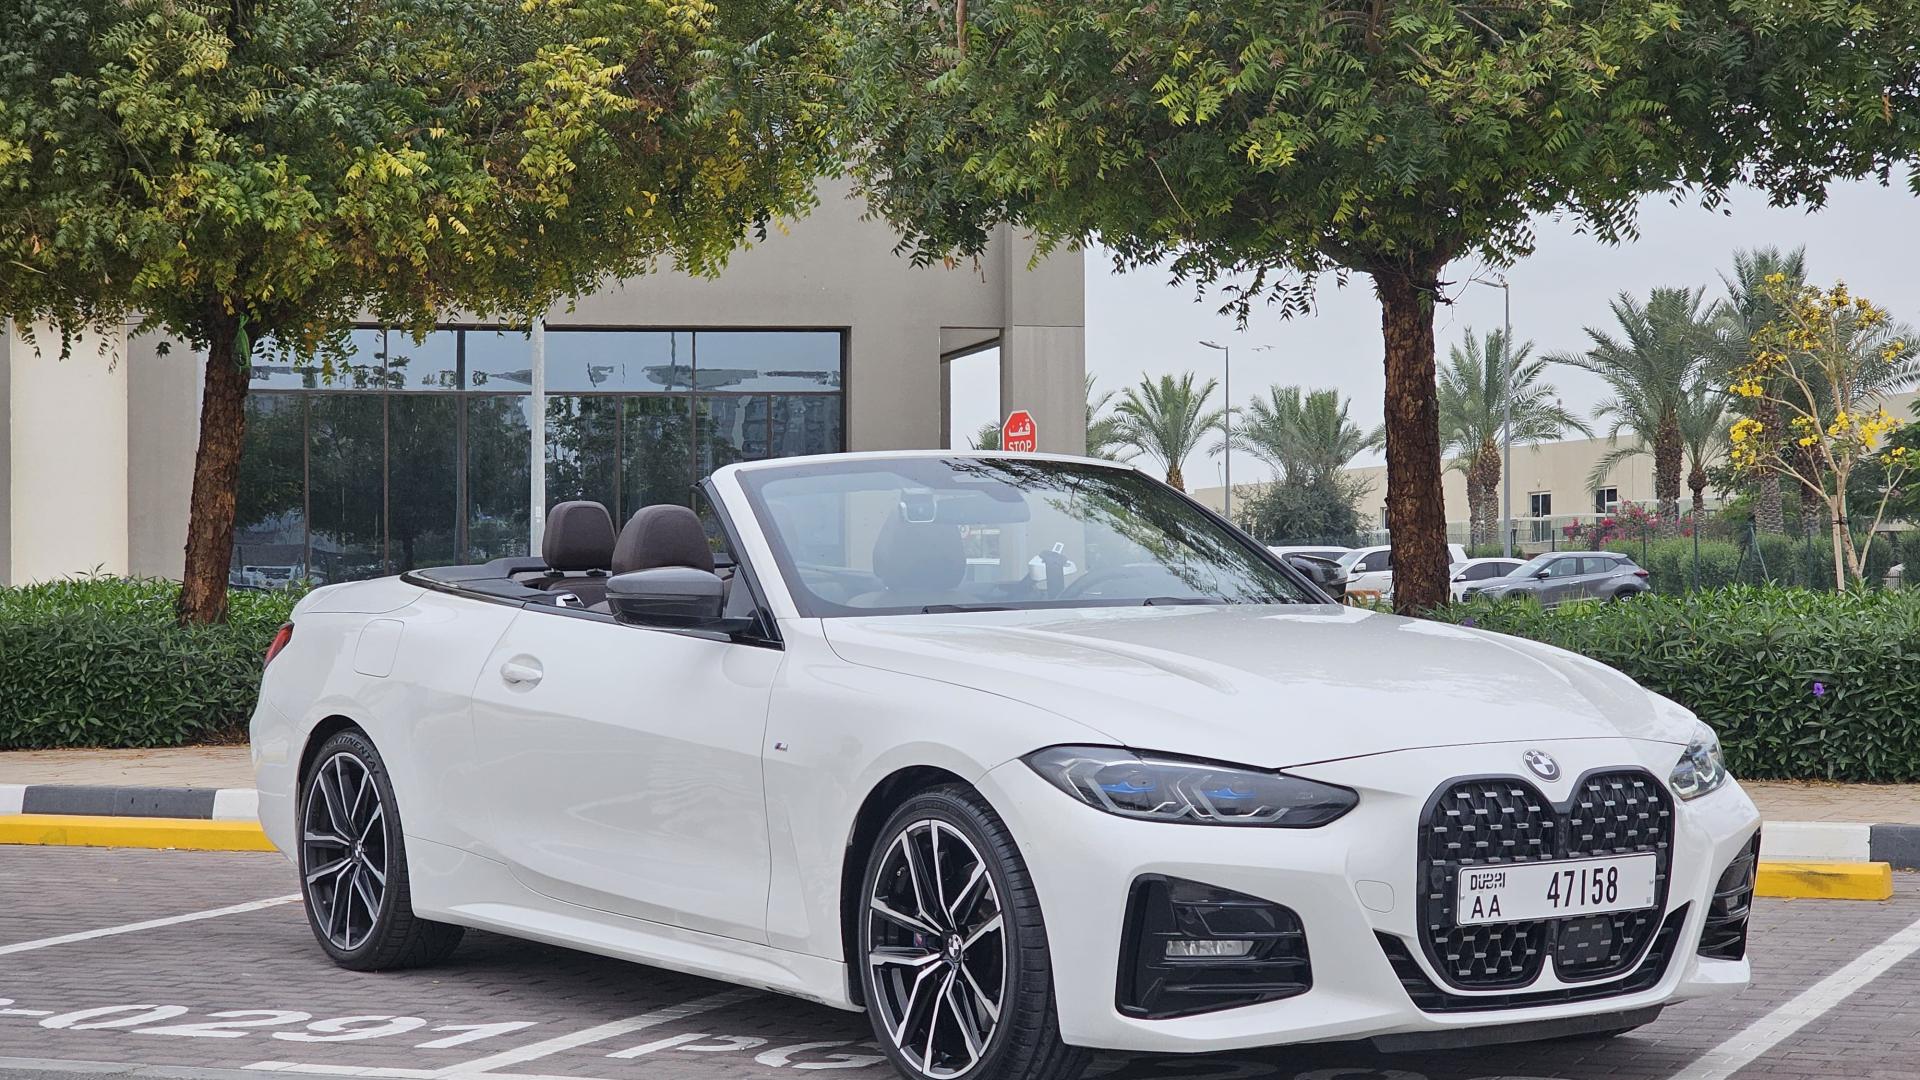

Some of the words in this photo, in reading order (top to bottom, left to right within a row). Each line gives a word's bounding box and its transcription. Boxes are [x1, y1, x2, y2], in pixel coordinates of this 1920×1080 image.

[1008, 440, 1032, 452] STOP
[1470, 872, 1506, 891] DUBAI
[1547, 867, 1618, 908] 47158
[1471, 894, 1501, 919] AA
[0, 998, 539, 1049] -0291
